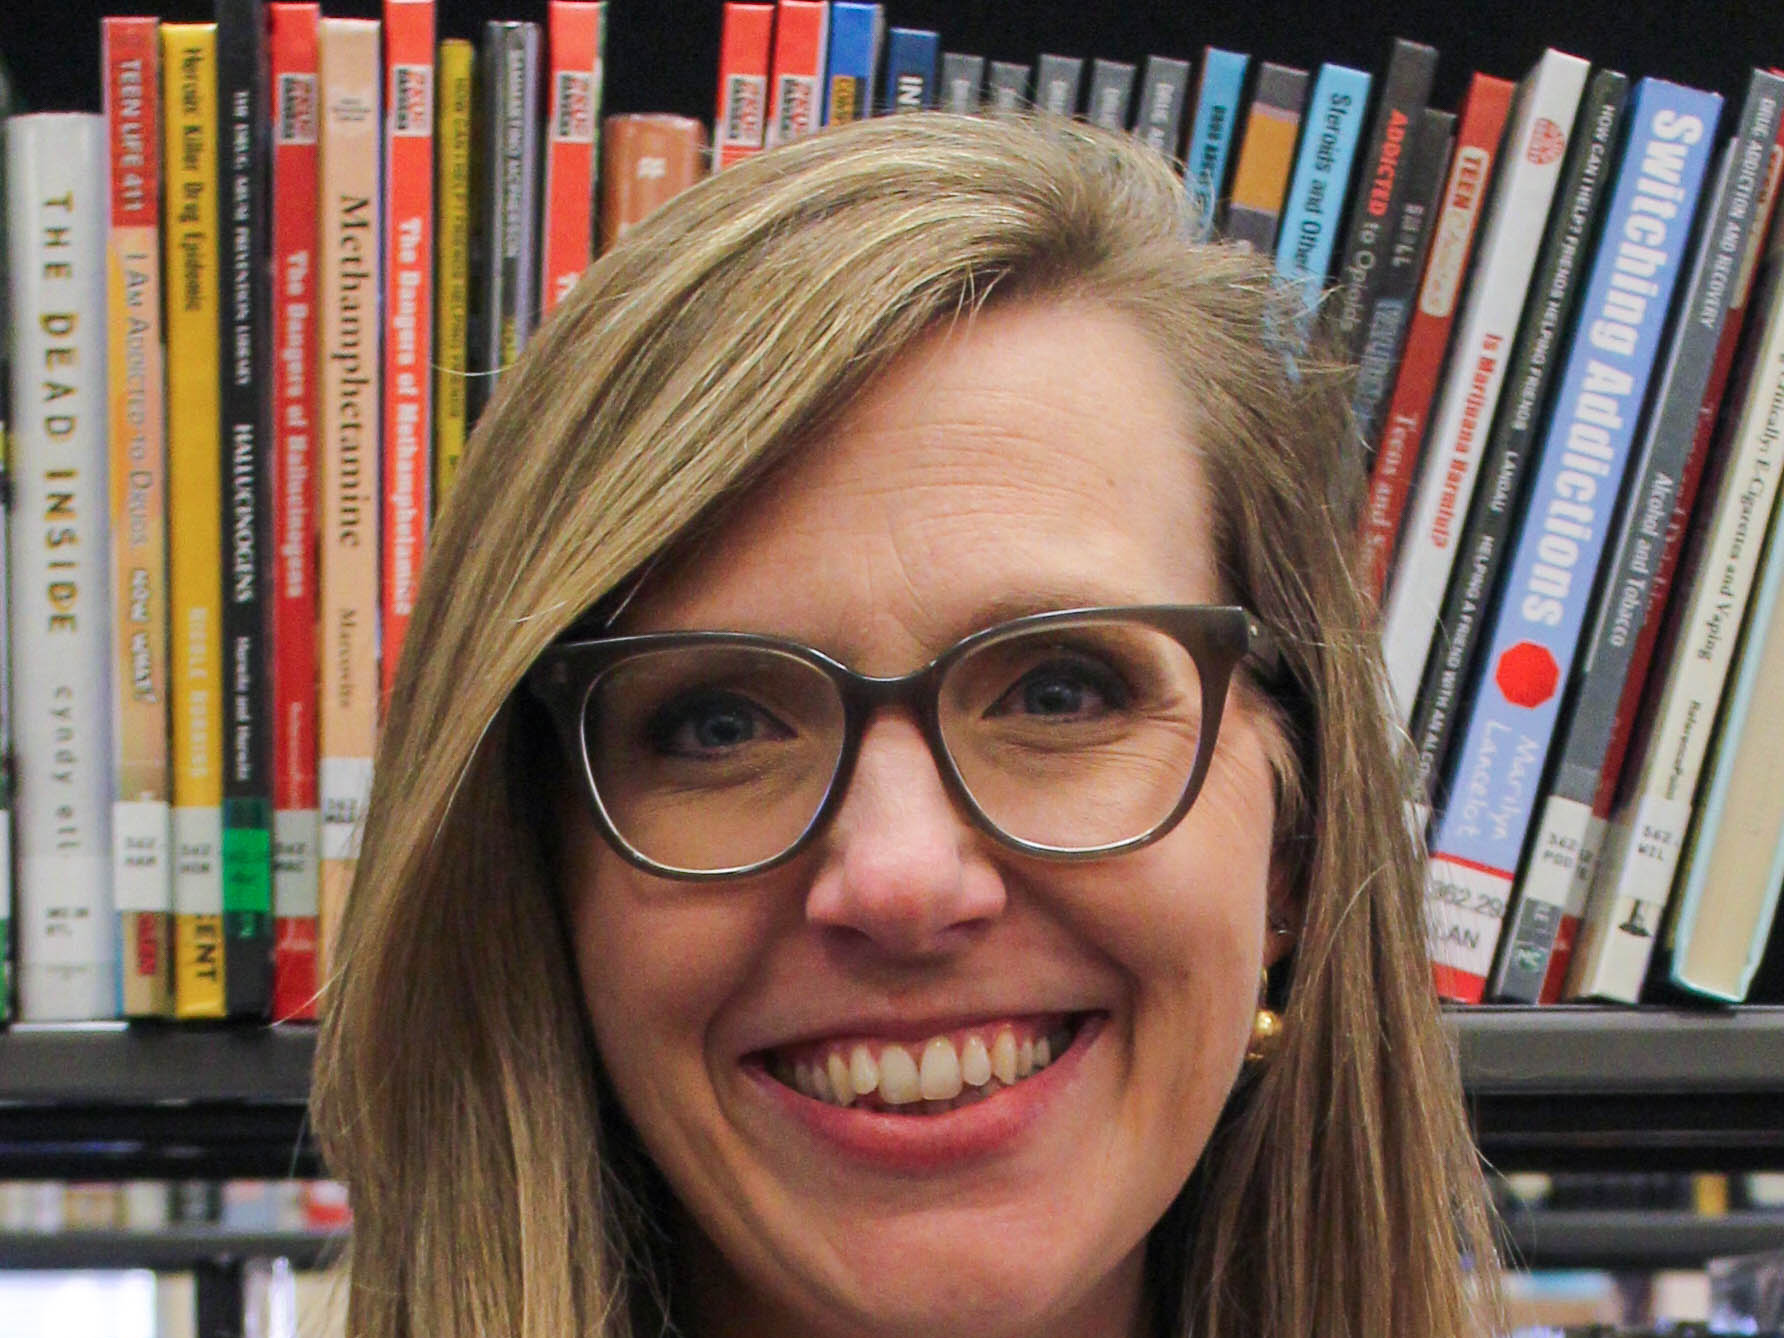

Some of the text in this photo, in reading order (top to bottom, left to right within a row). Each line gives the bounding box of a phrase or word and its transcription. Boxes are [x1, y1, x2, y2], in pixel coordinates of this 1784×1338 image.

[120, 59, 143, 117] TEEN
[1751, 97, 1775, 138] DRUG
[120, 122, 143, 168] LIFE
[1593, 103, 1614, 142] HOW
[1292, 91, 1351, 272] Steroids and Other
[1367, 107, 1410, 217] ADDICTED
[1451, 154, 1483, 211] TEEN
[1584, 143, 1604, 177] CAN
[1728, 139, 1763, 219] ADDICTION
[180, 181, 205, 224] Drug
[1358, 220, 1379, 245] to
[1588, 106, 1705, 359] Switching
[399, 216, 423, 263] The
[1550, 234, 1579, 300] FRIENDS
[1719, 221, 1741, 252] AND
[286, 250, 309, 296] The
[1698, 254, 1733, 328] RECOVERY
[283, 303, 309, 396] Dangers
[394, 270, 421, 365] Dangers
[1532, 299, 1560, 364] HELPING
[330, 195, 372, 548] Methamphetamine
[398, 373, 419, 397] of
[1513, 365, 1542, 432] FRIENDS
[39, 189, 80, 633] THE DEAD INSIDE
[288, 405, 309, 427] of
[1427, 333, 1503, 548] Is Marijuana Harmful?
[232, 423, 255, 602] HALLUCINOGENS
[1518, 359, 1636, 629] Addictions
[1637, 470, 1675, 537] Alcohol
[1465, 534, 1495, 600] HELPING
[1629, 537, 1656, 574] and
[1719, 564, 1739, 597] and
[1461, 599, 1477, 614] A
[1605, 575, 1645, 648] Tobacco
[1697, 598, 1729, 663] Vaping
[1446, 614, 1473, 668] FRIEND
[1435, 668, 1457, 708] WITH
[50, 685, 78, 785] cyndy
[1456, 719, 1513, 840] Lancelot
[1483, 734, 1541, 844] Marilyn
[195, 914, 217, 984] ENT
